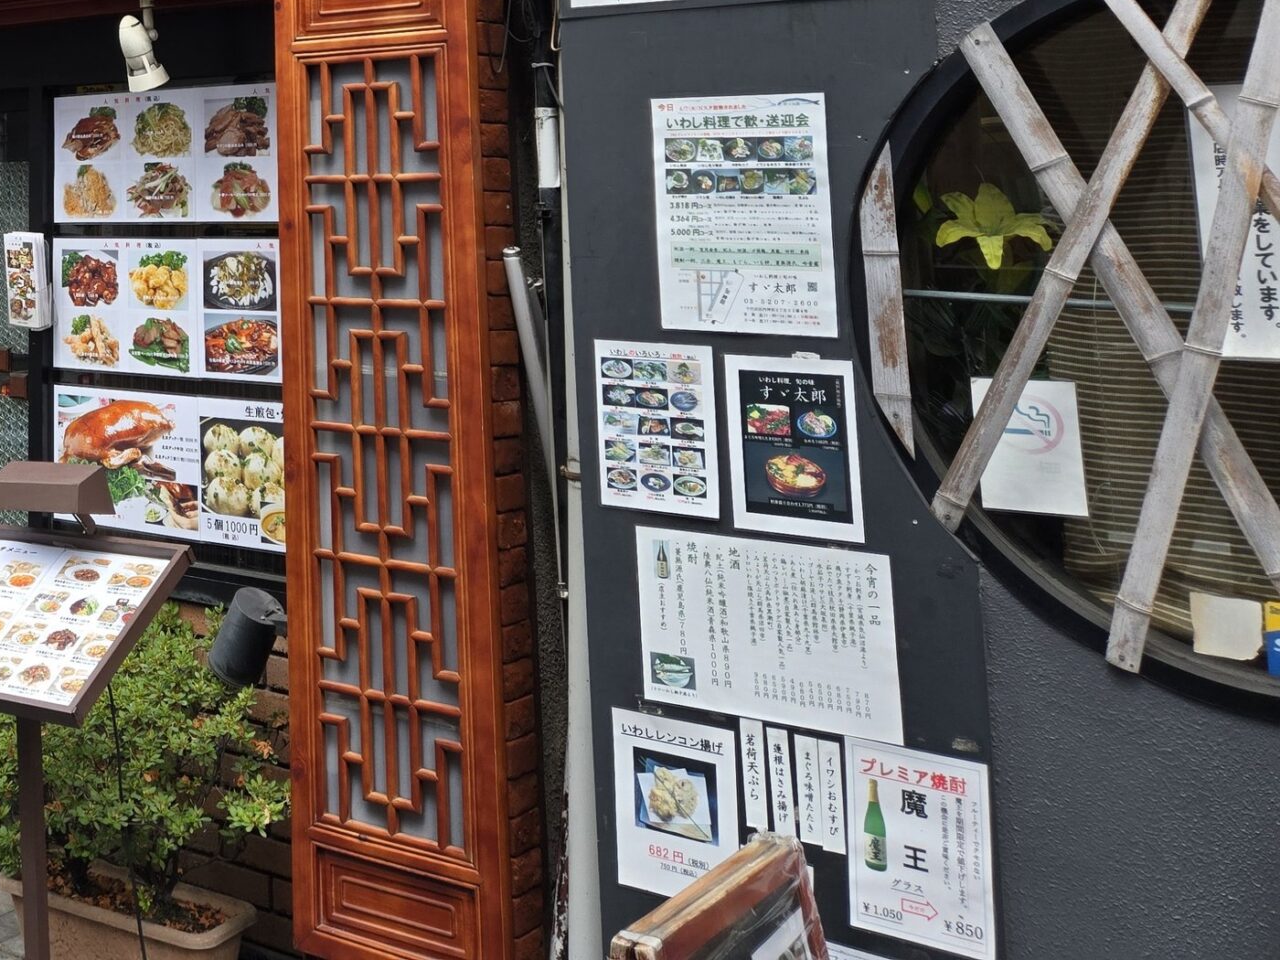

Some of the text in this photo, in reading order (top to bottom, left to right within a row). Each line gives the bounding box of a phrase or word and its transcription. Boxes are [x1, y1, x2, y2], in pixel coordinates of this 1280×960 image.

[658, 103, 674, 111] 今日
[666, 113, 810, 129] いわし料理で歓・送迎会
[760, 385, 827, 405] すゞ太郎
[245, 406, 283, 420] 生煎包・
[207, 518, 258, 536] 5個1000円
[686, 541, 698, 565] 焼酎
[728, 547, 741, 571] 地酒
[864, 562, 881, 626] 今宵の一品
[621, 723, 724, 753] いわしレンコン揚げ
[745, 734, 759, 800] 茗荷天ぷら
[860, 758, 967, 794] プレミア焼酎
[773, 743, 789, 822] 蓮根はさみ揚げ
[804, 751, 814, 833] まぐろ味噌たたき
[826, 757, 839, 836] イワシおむすび
[900, 789, 929, 873] 魔王
[648, 844, 684, 864] 682円
[892, 878, 924, 893] グラス
